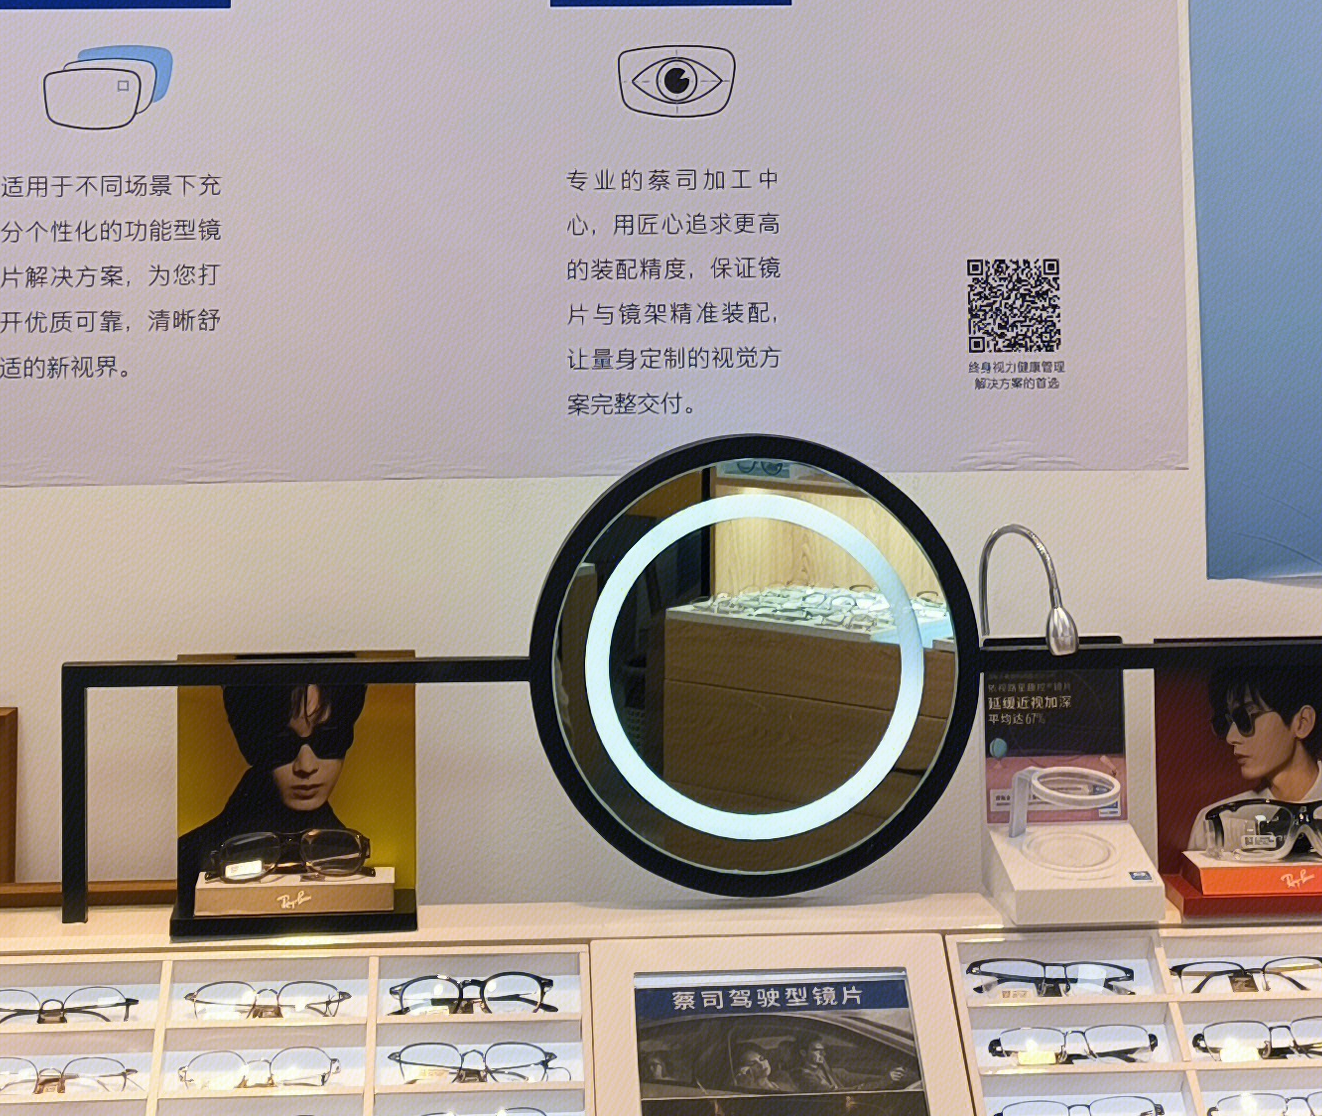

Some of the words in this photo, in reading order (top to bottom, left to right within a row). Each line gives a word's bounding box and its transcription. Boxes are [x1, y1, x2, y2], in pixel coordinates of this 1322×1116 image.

[1, 173, 222, 197] 适用于不同场景下充
[566, 168, 779, 192] 专业的蔡司加工中
[1, 219, 221, 243] 分个性化的功能型镜
[566, 213, 780, 236] 心，用匠心追求更高
[0, 264, 221, 288] 片解决方案，为您打
[566, 257, 781, 281] 的装配精度，保证镜
[0, 309, 221, 334] 开优质可靠，清晰舒
[0, 355, 131, 379] 适的新视界。
[567, 346, 781, 370] 让量身定制的视觉方
[968, 361, 1065, 374] 终身视力健康管理
[974, 377, 1060, 390] 解决方案的首选
[567, 393, 696, 416] 案完整交付。
[672, 985, 864, 1011] 蔡司驾驶型镜片
